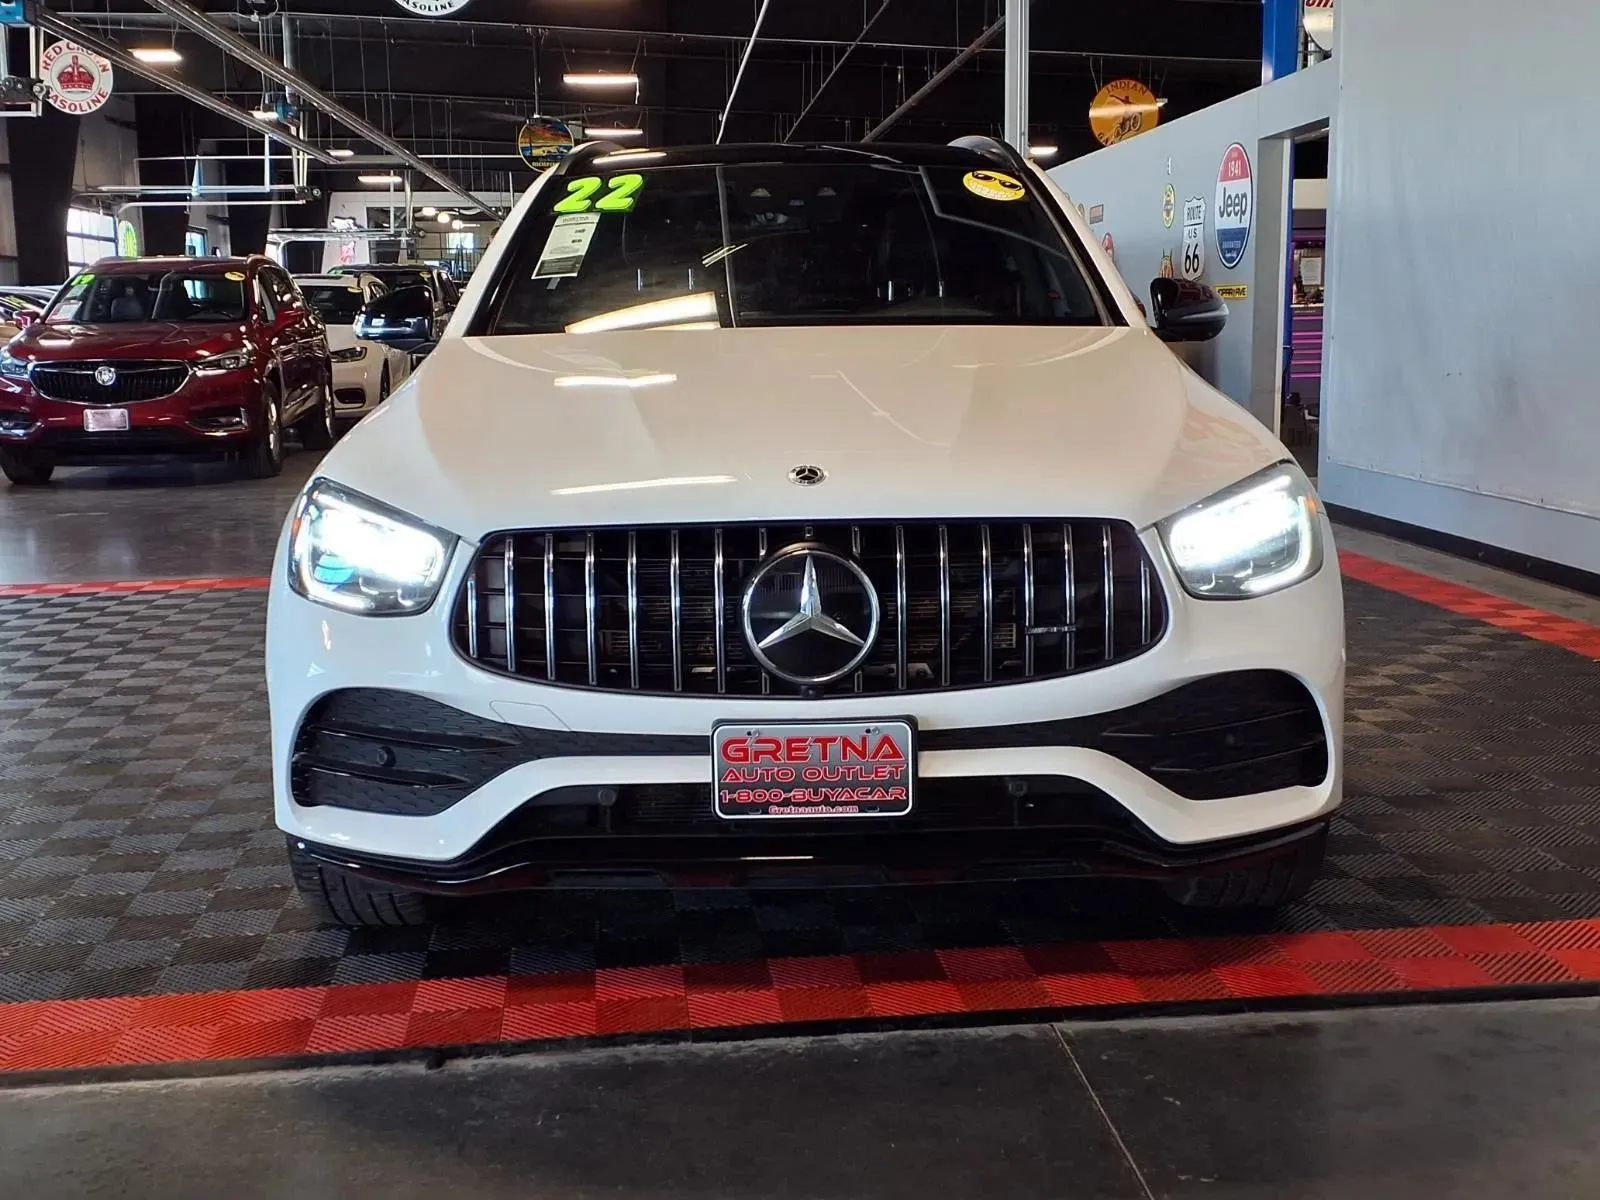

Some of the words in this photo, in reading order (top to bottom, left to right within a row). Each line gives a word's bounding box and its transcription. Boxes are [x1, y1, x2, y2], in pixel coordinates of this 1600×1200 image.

[42, 44, 63, 71] RED
[1105, 80, 1148, 96] INDIAN
[49, 87, 109, 113] ASOLINE
[1228, 159, 1242, 177] 1941
[553, 174, 644, 213] 22
[1218, 186, 1248, 224] Jeep
[1187, 205, 1202, 221] ROUTE
[1188, 228, 1198, 239] US
[1184, 242, 1200, 274] 66
[720, 735, 906, 765] GRETNA
[720, 766, 796, 783] AUTO
[802, 763, 907, 782] OUTLET
[720, 786, 907, 804] 1-800-BUYACAR
